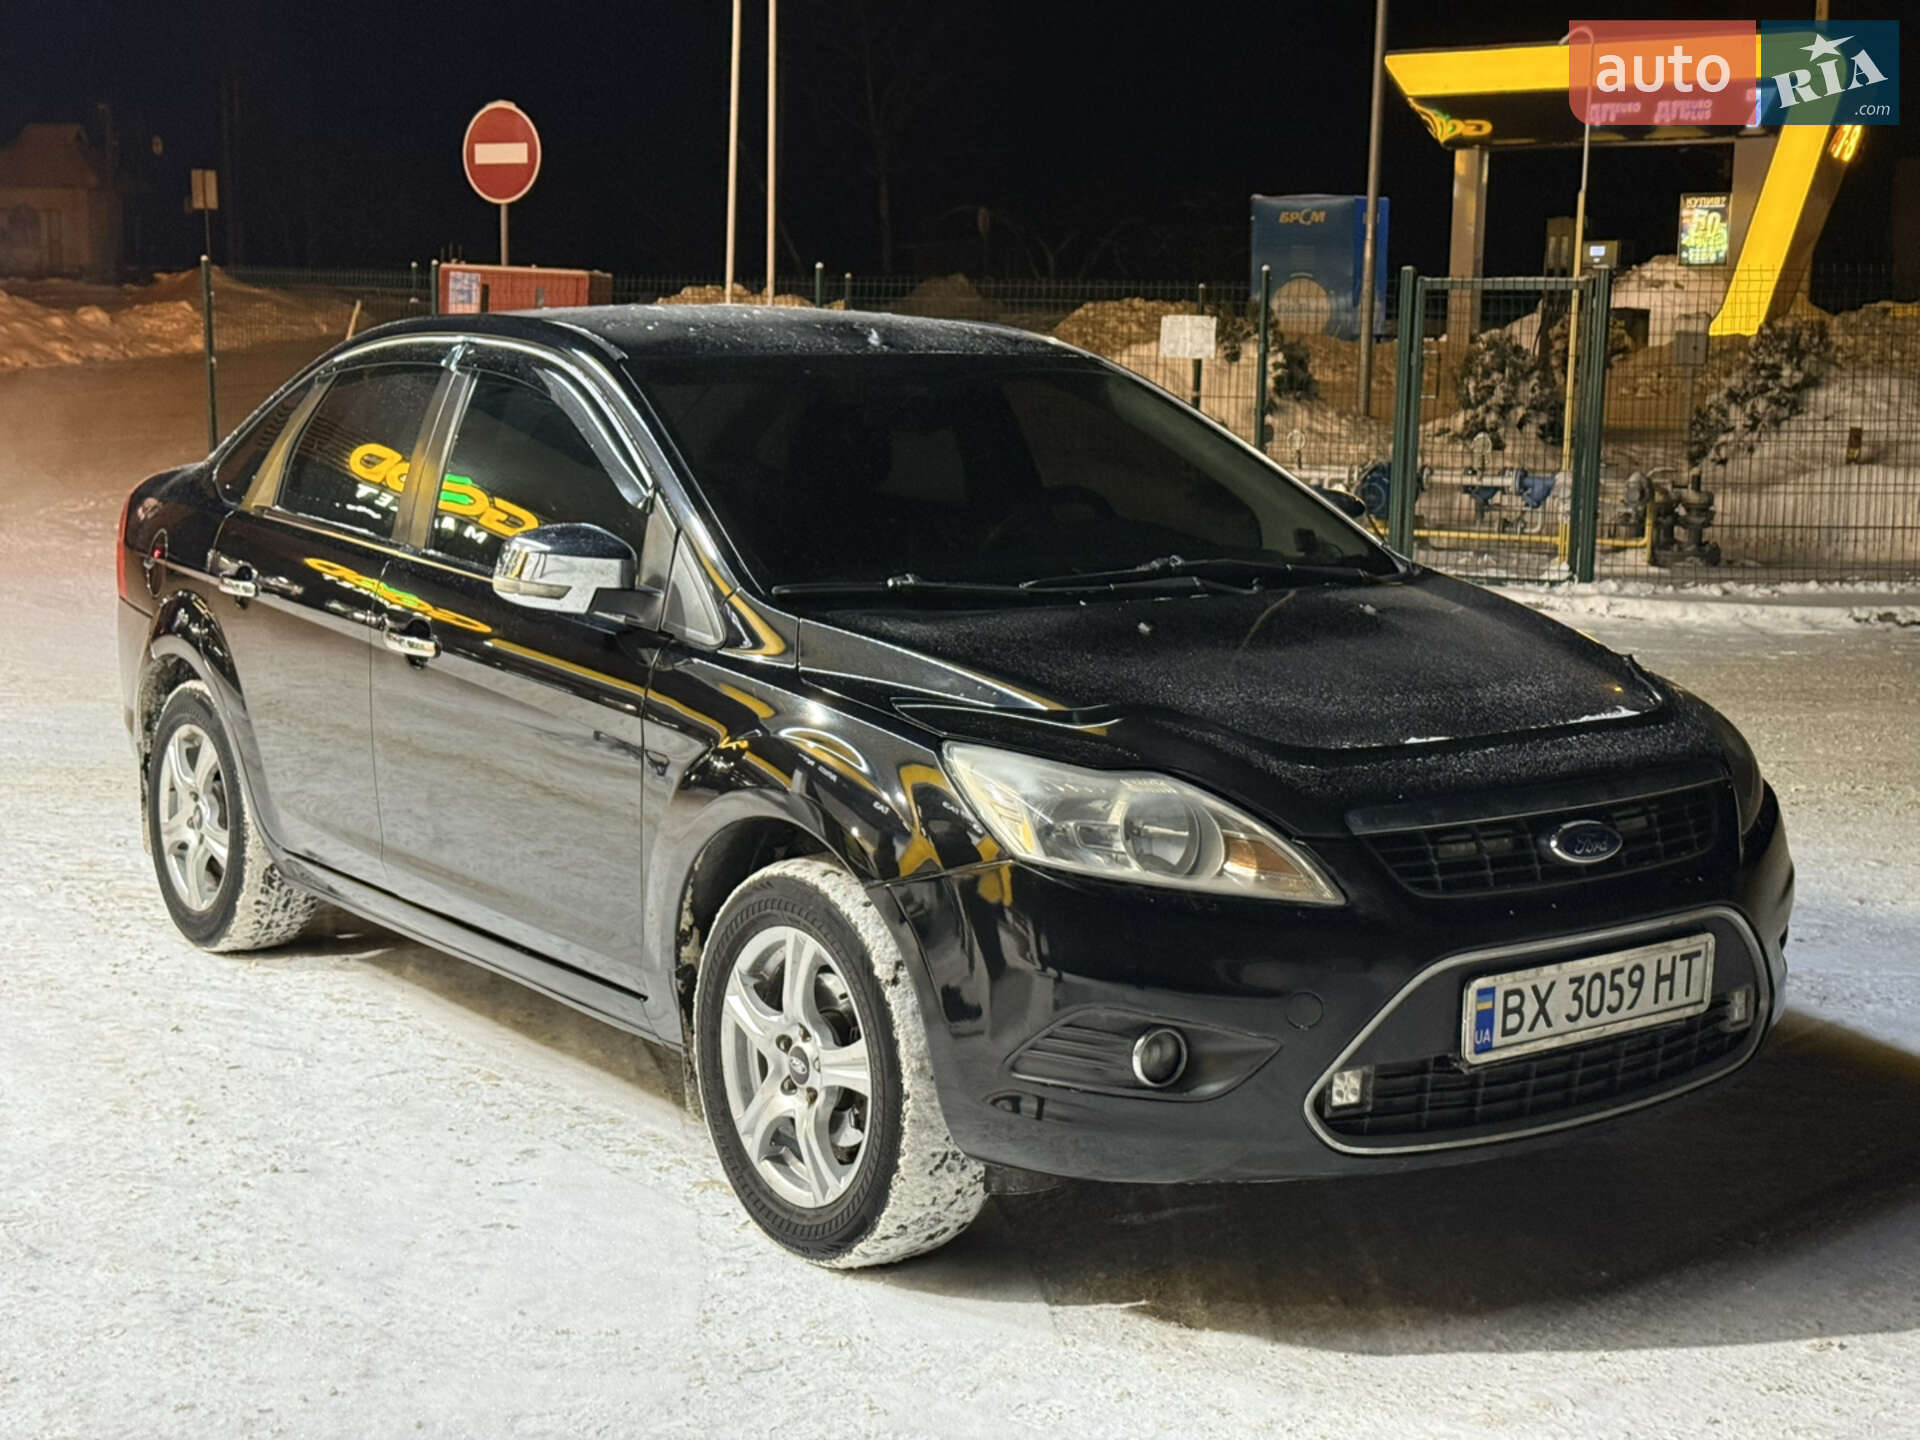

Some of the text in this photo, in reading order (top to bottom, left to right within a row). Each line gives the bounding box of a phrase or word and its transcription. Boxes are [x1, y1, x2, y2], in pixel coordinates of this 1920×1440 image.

[1501, 951, 1703, 1038] BX 3059 HT
[1475, 1027, 1491, 1045] UA
